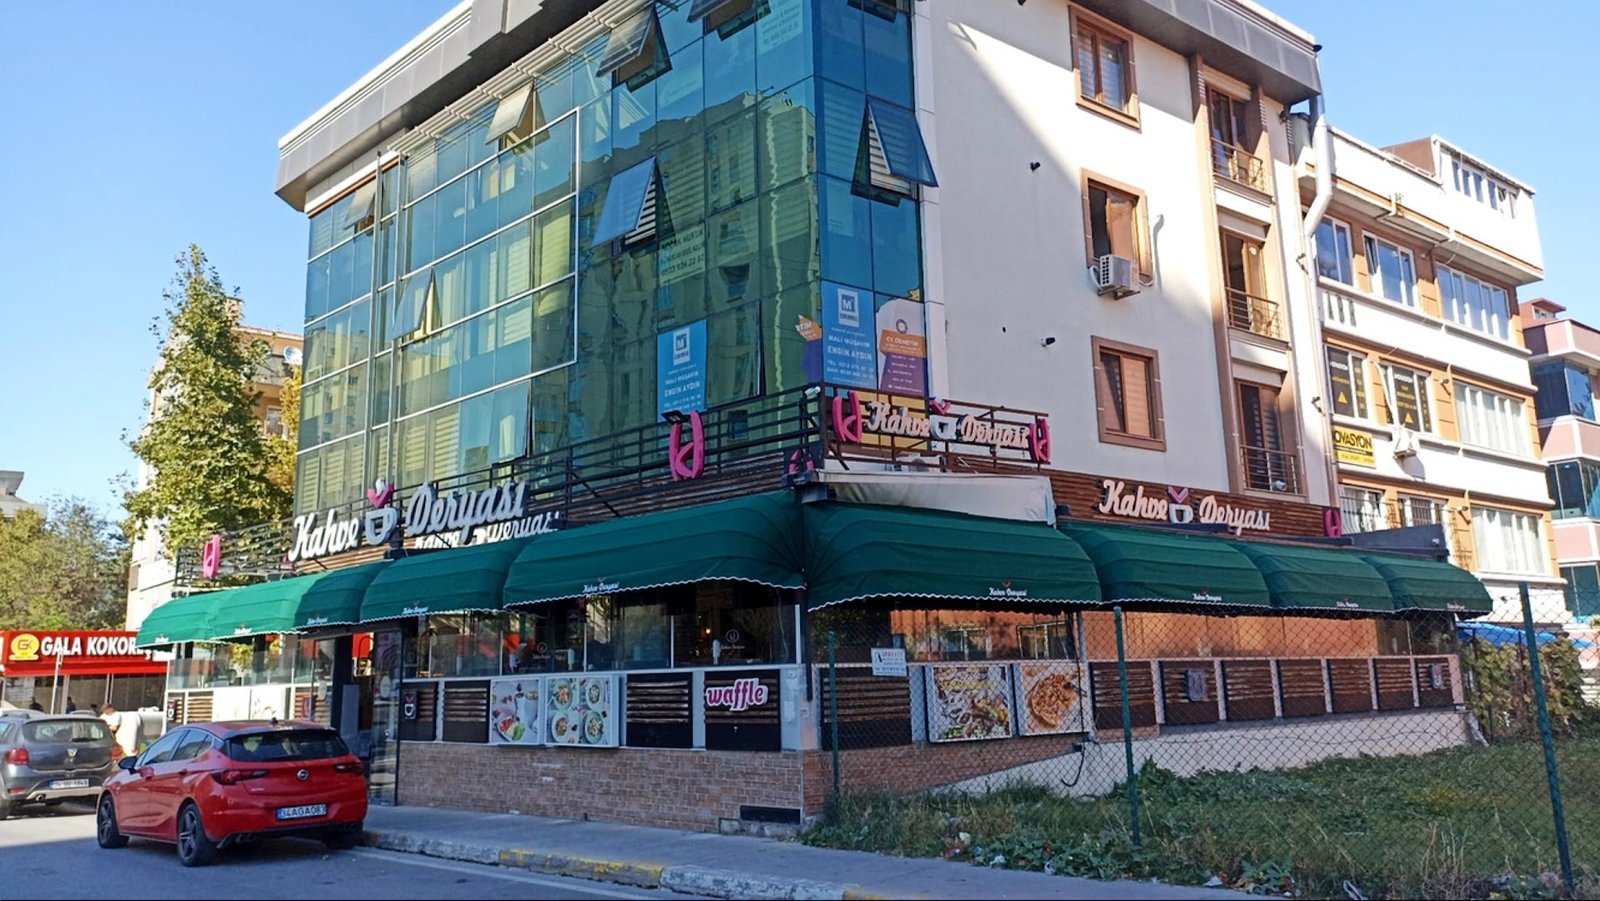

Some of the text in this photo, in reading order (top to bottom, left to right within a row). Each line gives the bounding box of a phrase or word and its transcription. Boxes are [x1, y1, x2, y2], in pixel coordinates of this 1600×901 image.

[865, 401, 1030, 451] Kahve Deryası
[289, 480, 528, 563] Kahve Deryası
[1099, 479, 1271, 536] Kahve Deryası
[41, 636, 82, 656] GALA
[706, 678, 769, 712] waffle
